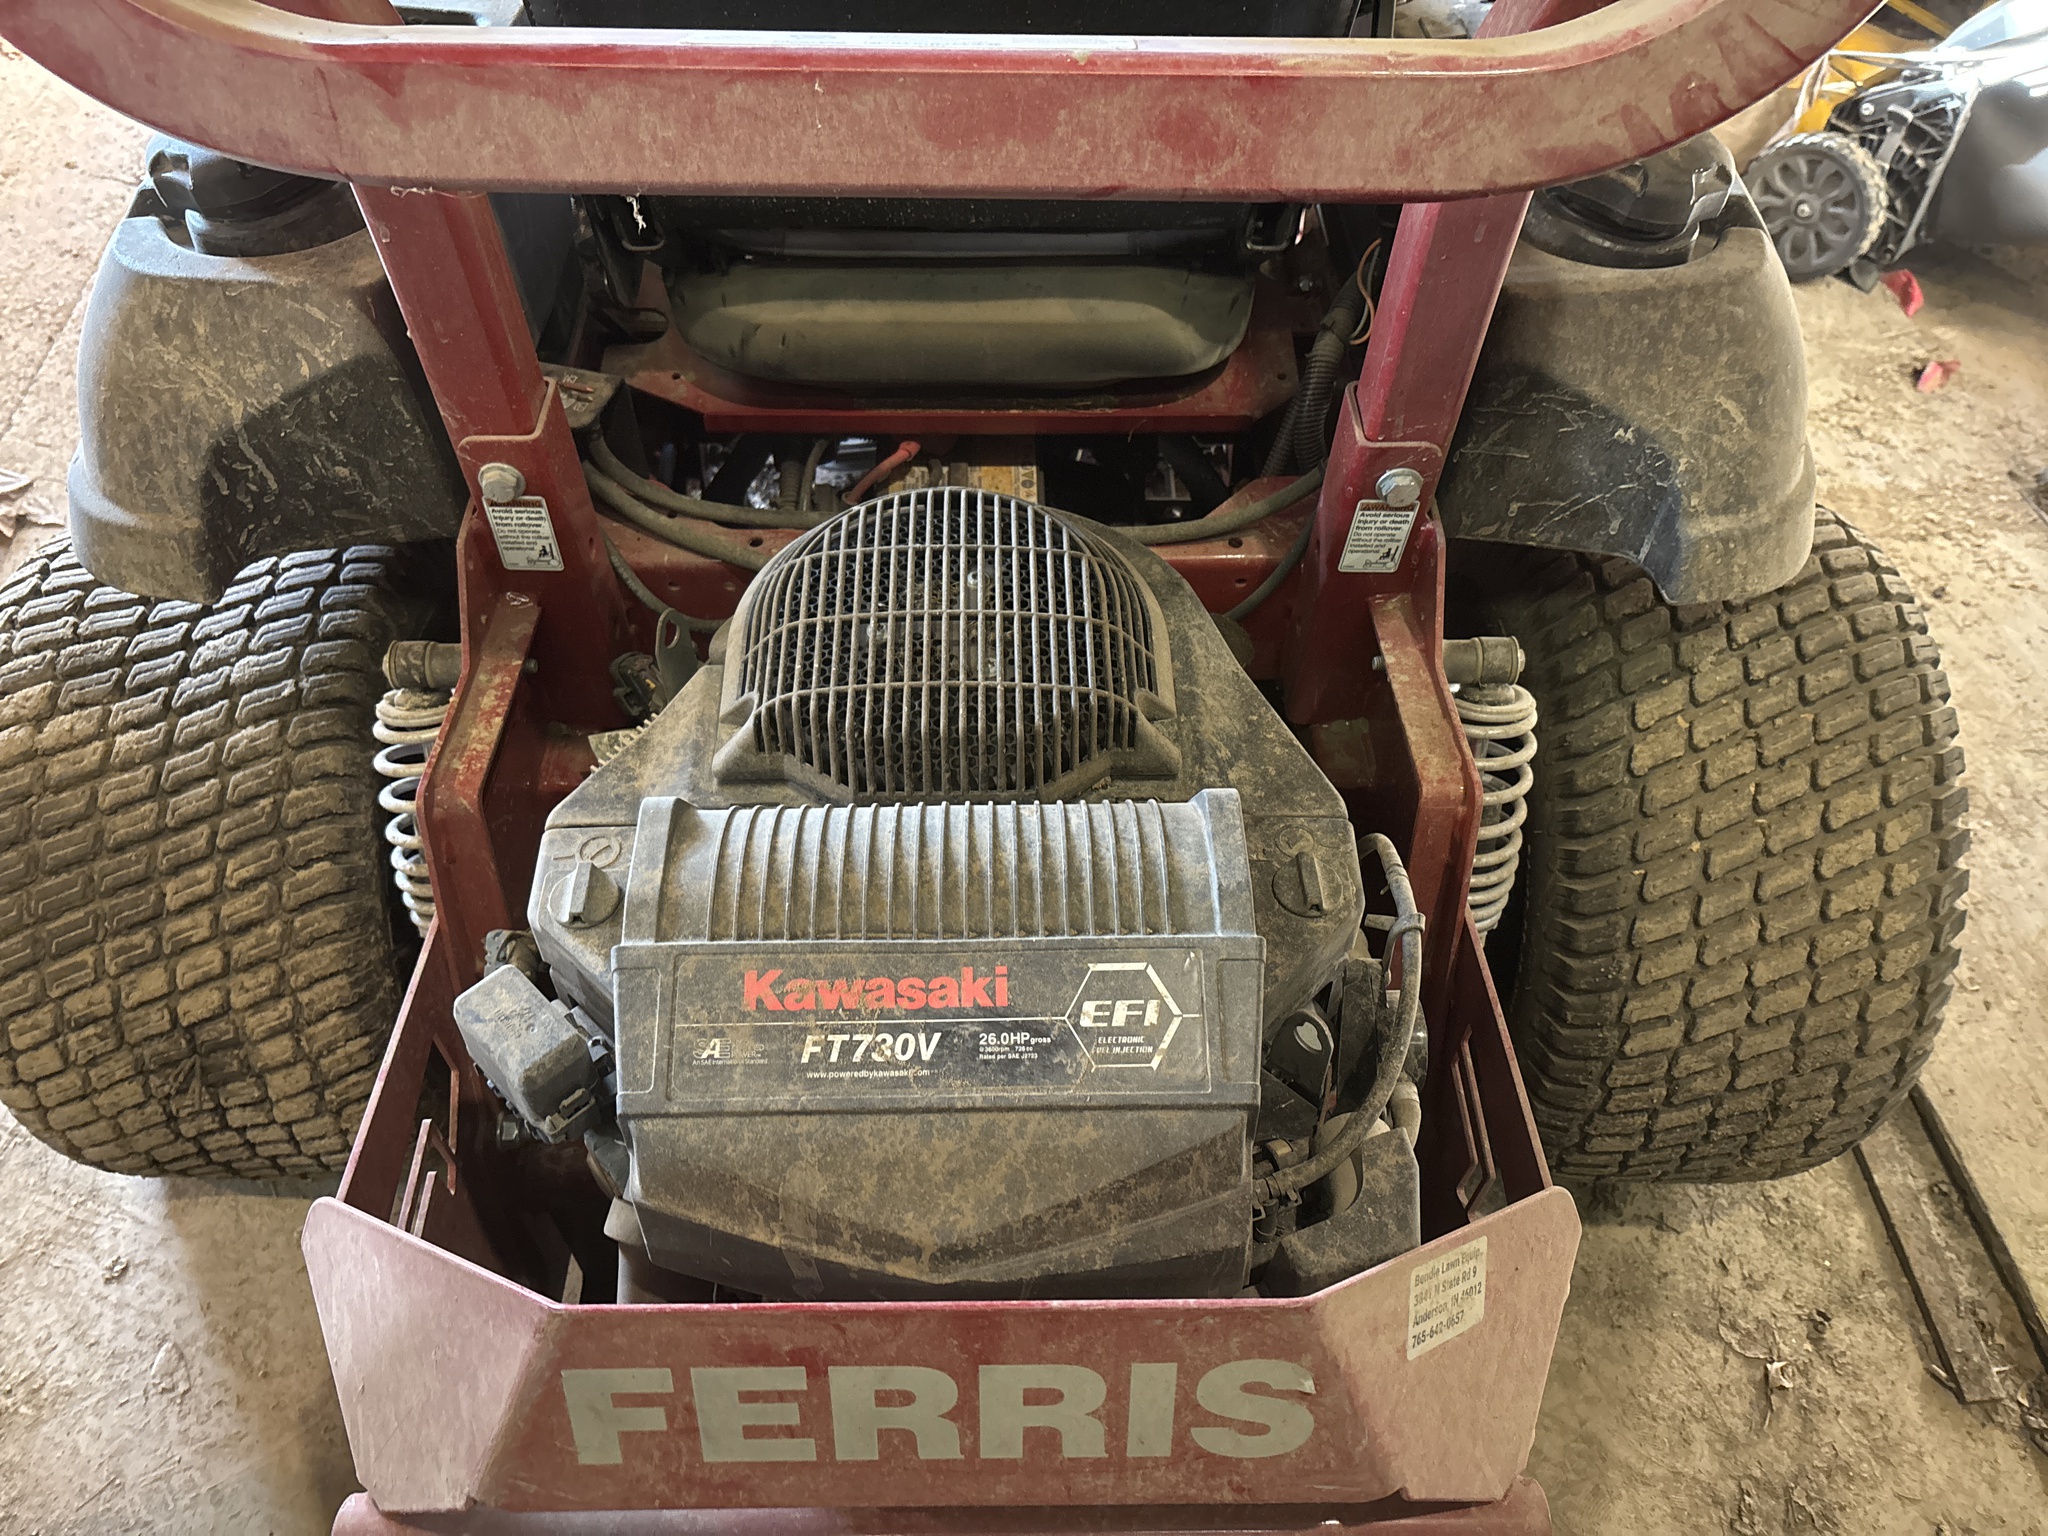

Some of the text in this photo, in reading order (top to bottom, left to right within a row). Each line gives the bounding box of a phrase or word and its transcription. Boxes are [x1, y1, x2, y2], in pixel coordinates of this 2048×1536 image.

[744, 965, 1009, 1011] Kawasaki
[1080, 1000, 1160, 1027] EFI
[801, 1032, 942, 1064] FT730V
[1098, 1036, 1145, 1044] ELECTRONIC
[1112, 1046, 1153, 1054] INJECTION
[807, 1068, 930, 1080] www.poweredbykawasakiom
[1441, 1256, 1460, 1274] Lawn
[1441, 1276, 1460, 1293] State
[1461, 1270, 1471, 1283] Rd
[1472, 1265, 1477, 1278] 9
[1451, 1293, 1459, 1306] IN
[560, 1358, 1316, 1465] FERRIS
